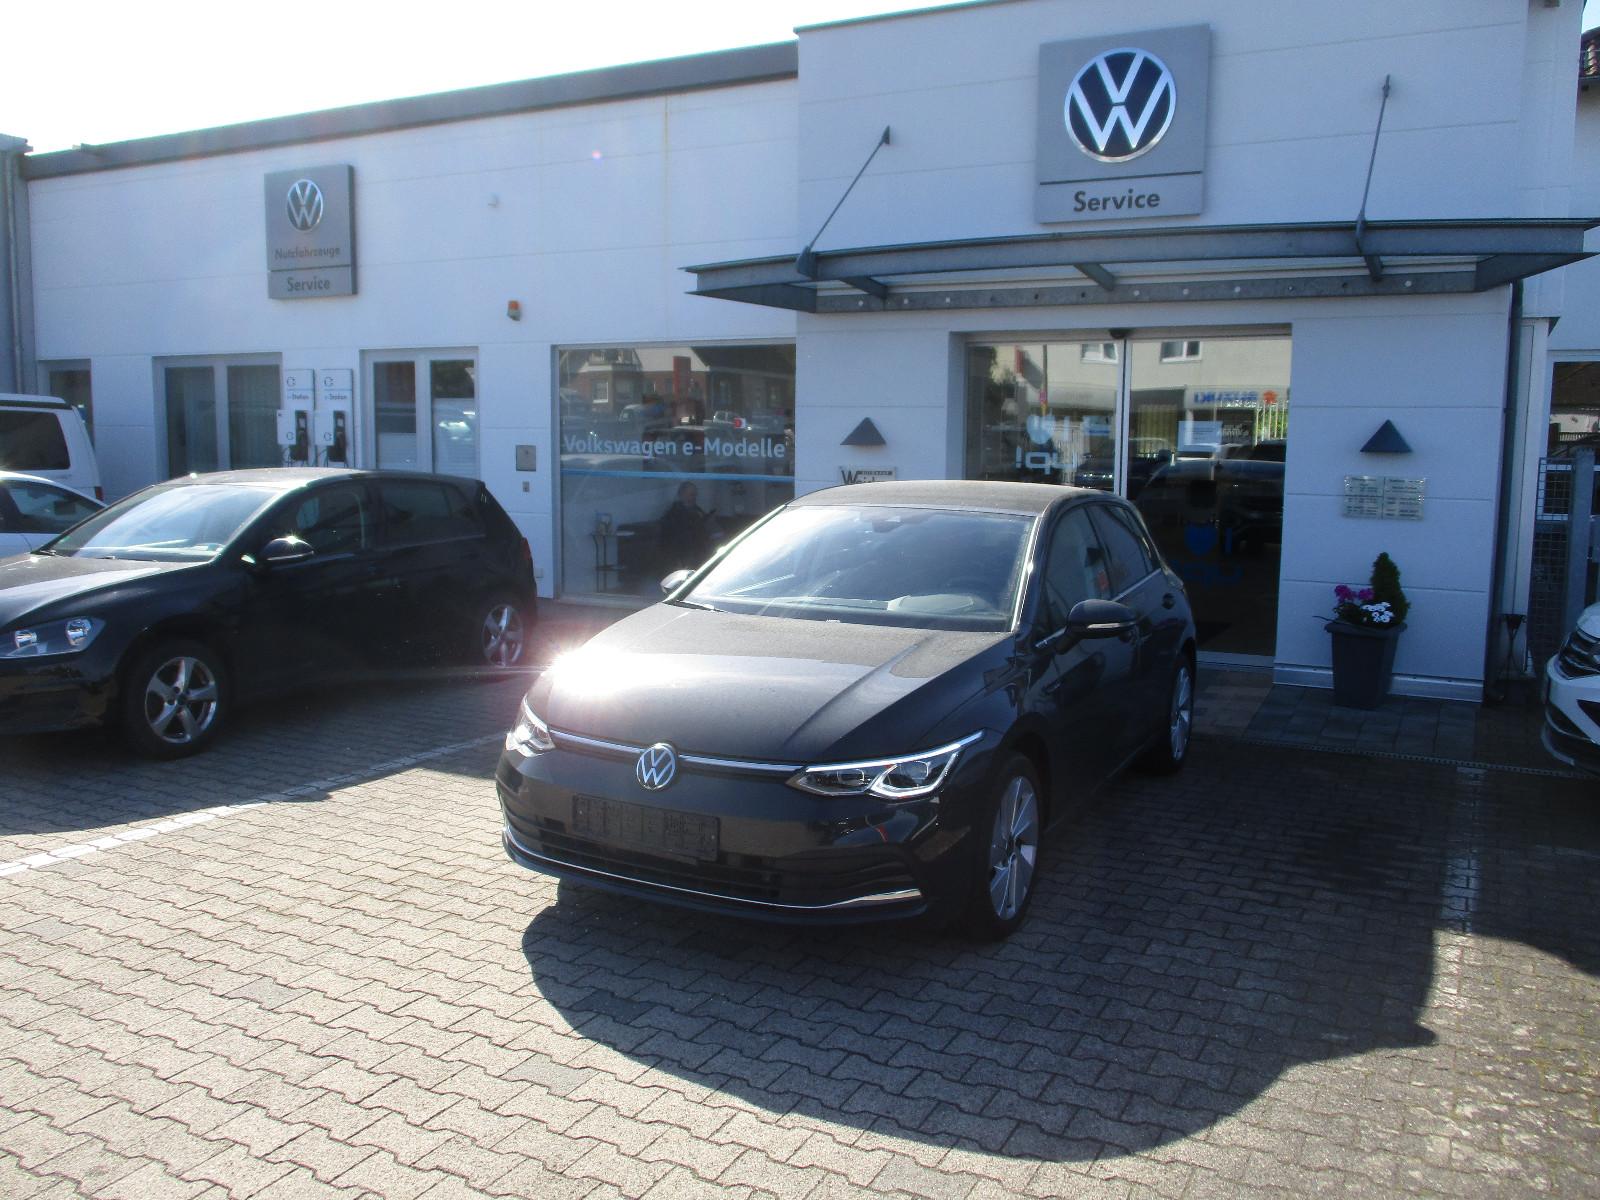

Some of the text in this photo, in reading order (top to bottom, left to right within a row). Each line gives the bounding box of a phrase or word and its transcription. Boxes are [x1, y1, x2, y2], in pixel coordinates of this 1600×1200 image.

[1064, 47, 1176, 163] VW
[1073, 188, 1161, 213] Service
[287, 275, 331, 292] Service
[564, 434, 785, 460] Volkswagen e-Modelle
[637, 743, 675, 790] VW
